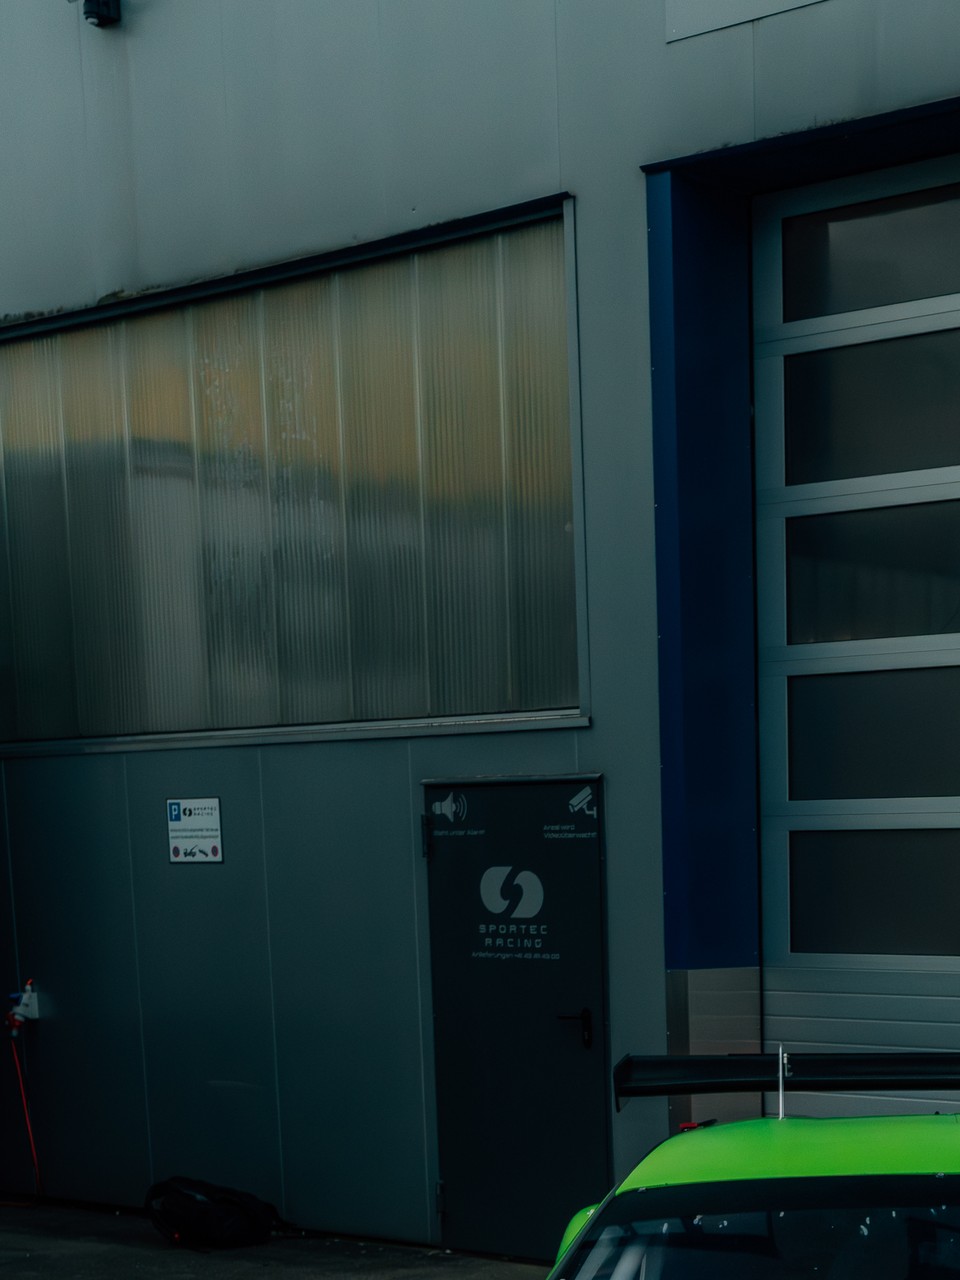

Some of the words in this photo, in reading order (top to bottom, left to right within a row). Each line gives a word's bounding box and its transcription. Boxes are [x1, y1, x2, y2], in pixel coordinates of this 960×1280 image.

[171, 804, 179, 820] P
[478, 924, 548, 934] SPORTEC
[484, 937, 542, 948] RACING
